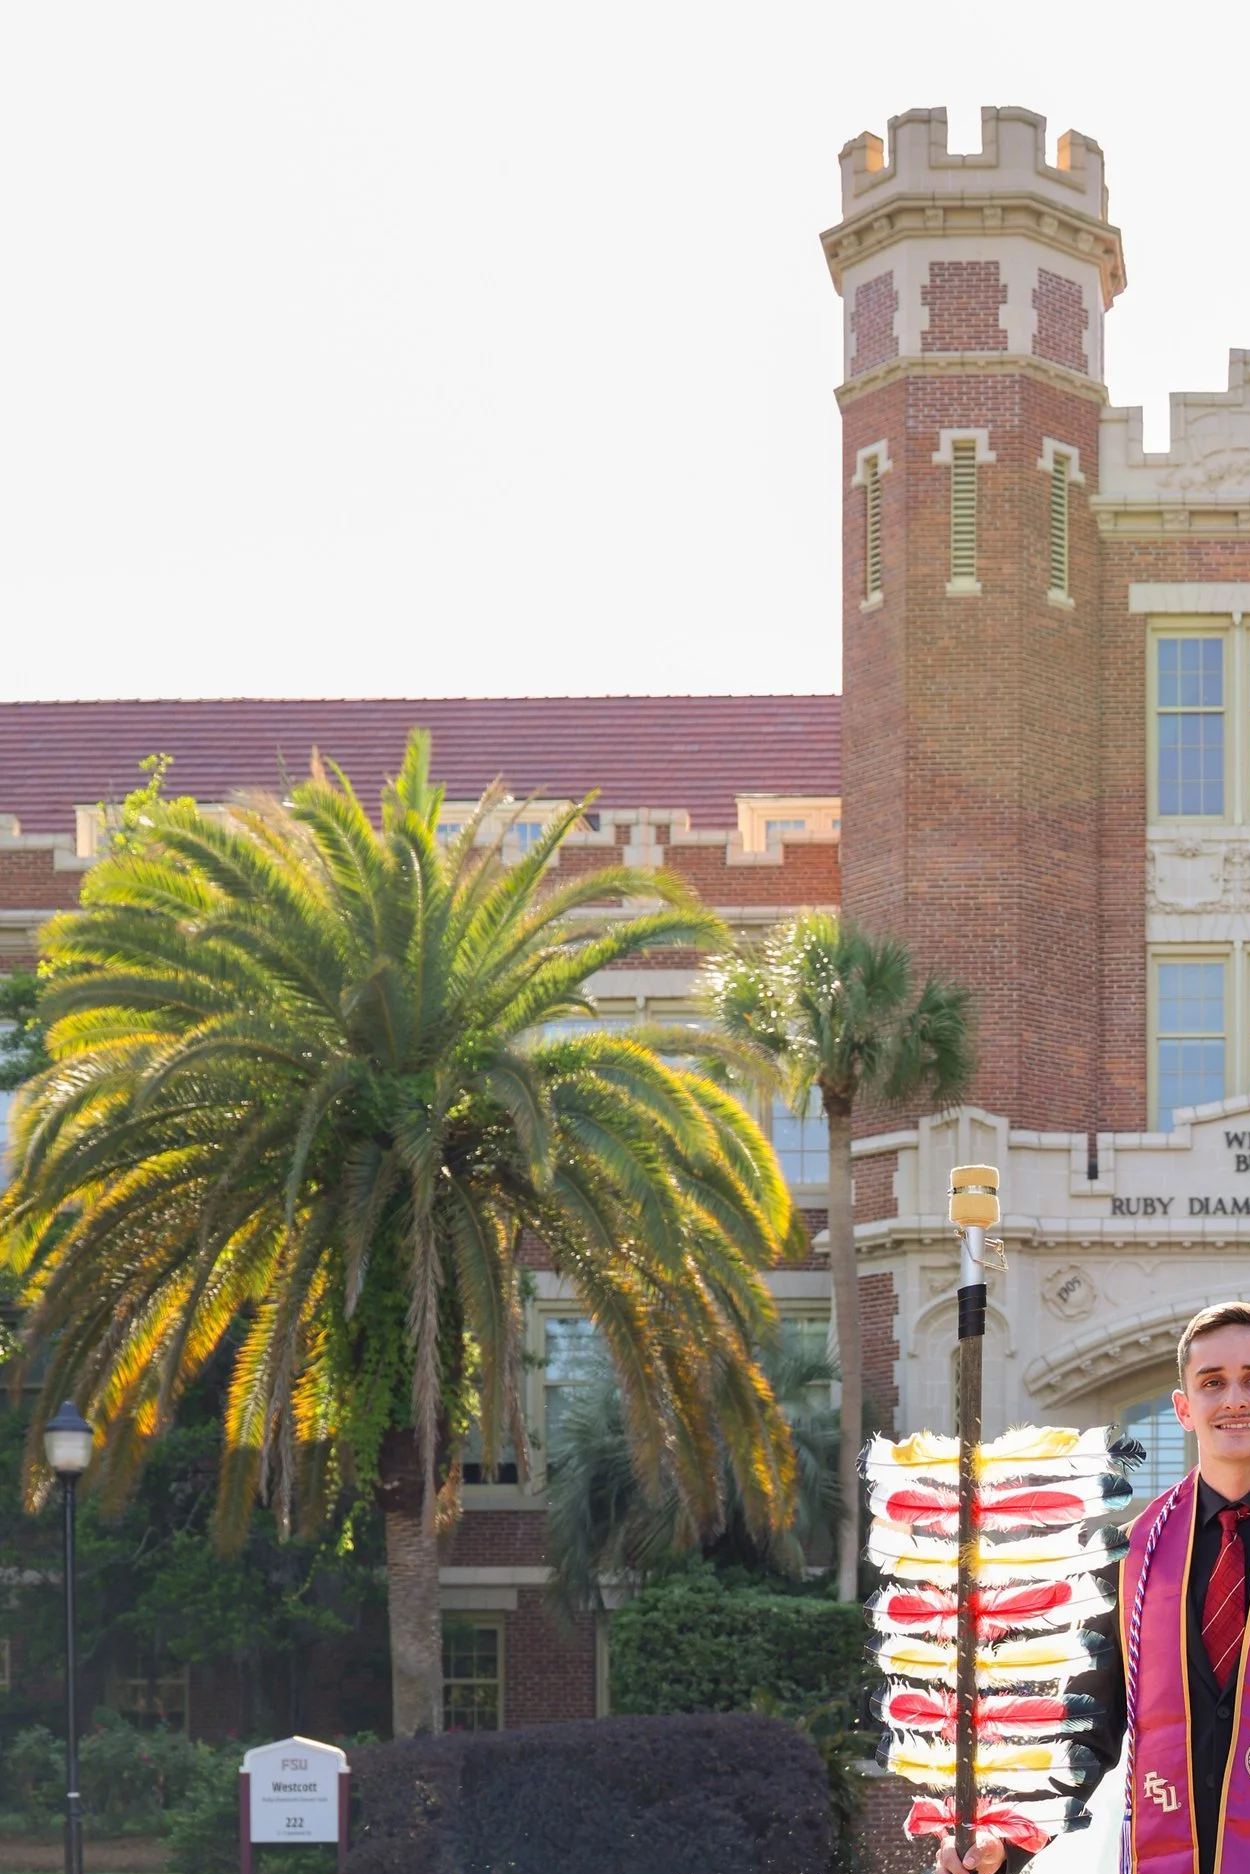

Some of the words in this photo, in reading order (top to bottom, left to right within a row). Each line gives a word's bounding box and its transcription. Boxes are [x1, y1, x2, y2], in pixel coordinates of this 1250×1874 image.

[1111, 1196, 1175, 1216] RUBY
[1056, 1275, 1082, 1304] 1905
[281, 1758, 308, 1772] FSU
[271, 1782, 318, 1793] Westcott
[1143, 1771, 1179, 1813] FSU
[285, 1817, 305, 1828] 222
